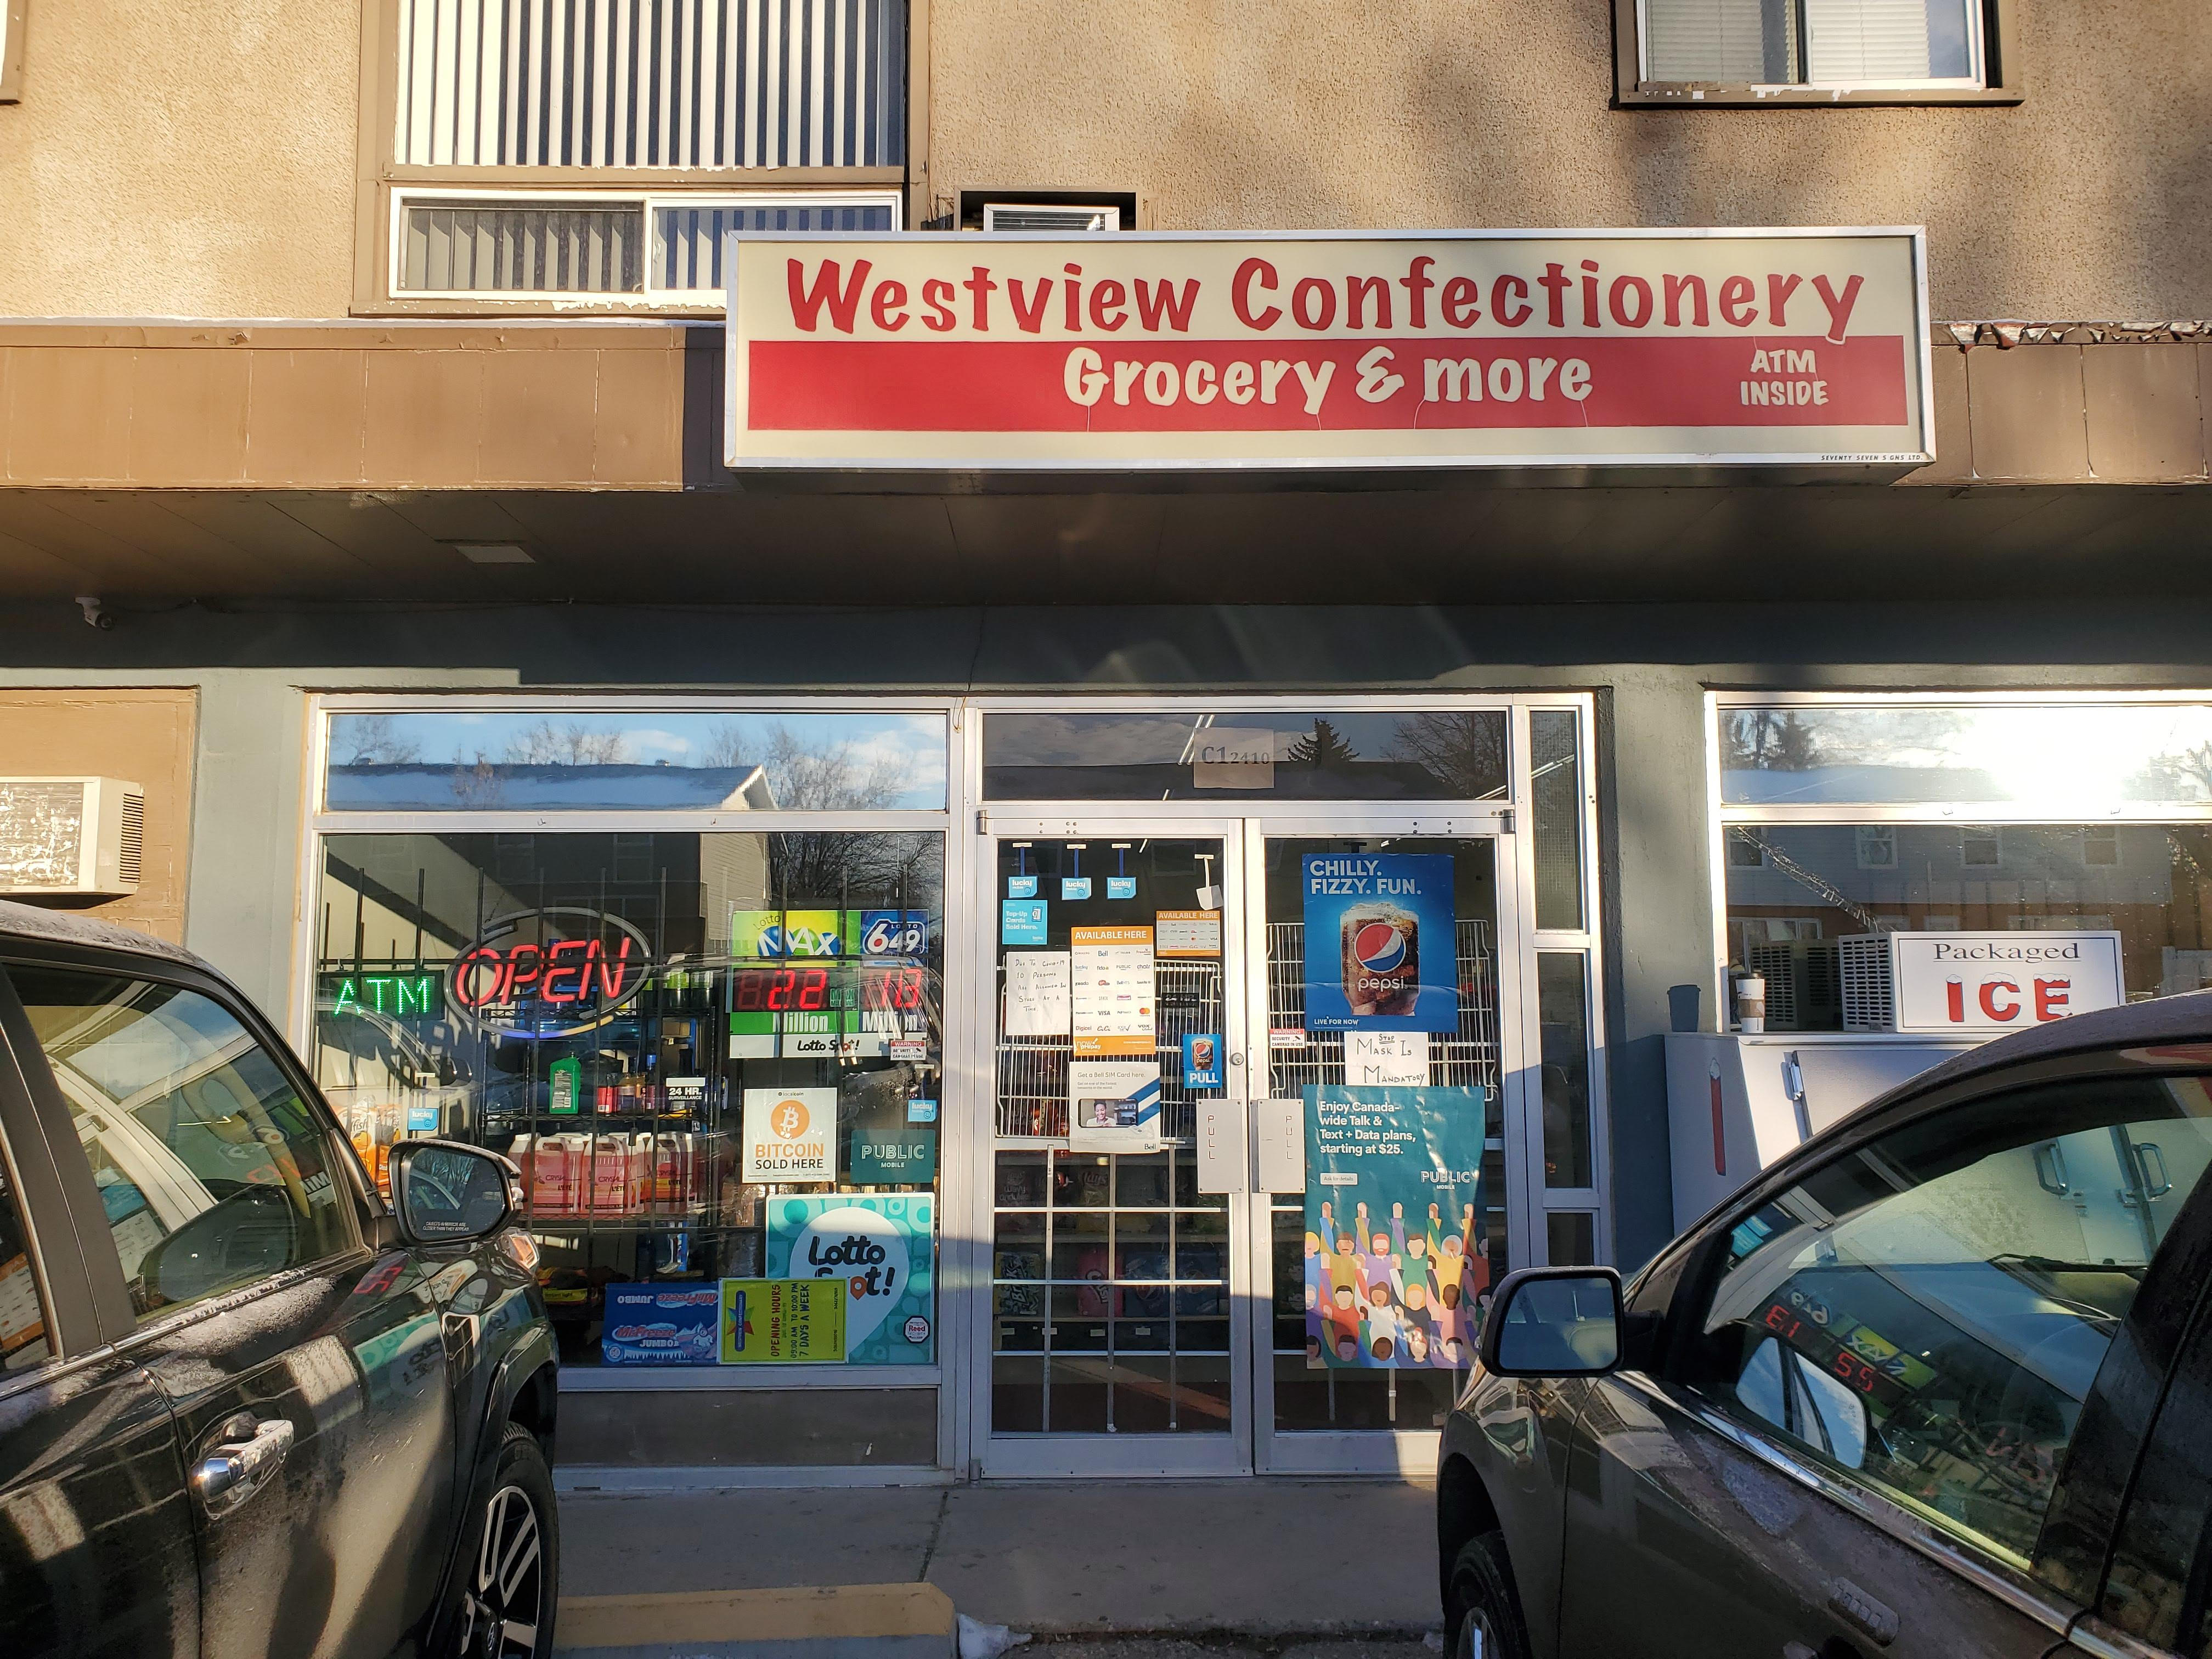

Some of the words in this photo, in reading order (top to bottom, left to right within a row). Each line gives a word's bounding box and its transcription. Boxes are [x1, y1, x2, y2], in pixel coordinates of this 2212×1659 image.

[787, 257, 1201, 334] Westview
[1231, 256, 1865, 344] Confectionery
[1750, 349, 1817, 374] ATM
[1063, 347, 1336, 415] Grocery
[1355, 346, 1405, 403] &
[1423, 357, 1593, 402] more
[1741, 381, 1830, 407] INSIDE
[1310, 860, 1382, 877] CHILLY.
[1311, 879, 1371, 894] FIZZY.
[1377, 879, 1421, 894] FUN.
[753, 913, 781, 930] Lotto
[867, 923, 921, 953] 649
[1124, 930, 1147, 939] HERE
[1933, 943, 2081, 964] Packaged
[456, 937, 631, 1007] OPEN
[1358, 975, 1404, 992] pepsi
[334, 978, 431, 1017] ATM
[1945, 972, 2073, 1023] ICE
[797, 1040, 826, 1051] Lotto
[1189, 1073, 1219, 1084] PULL
[1320, 1102, 1350, 1114] Enjoy
[1353, 1102, 1400, 1112] Canada-
[1320, 1116, 1347, 1126] wide
[1350, 1116, 1370, 1126] Talk
[1373, 1116, 1383, 1126] &
[1320, 1130, 1343, 1139] Text
[1355, 1130, 1380, 1140] Data
[1383, 1130, 1417, 1142] plans,
[755, 1143, 823, 1158] BITCOIN
[861, 1144, 925, 1159] PUBLIC
[1320, 1144, 1363, 1156] starting
[1365, 1145, 1376, 1154] at
[1379, 1144, 1403, 1154] $25.
[755, 1159, 788, 1170] SOLD
[792, 1159, 823, 1169] HERE
[1421, 1171, 1470, 1183] PUBLIC
[809, 1235, 885, 1266] Lotto
[792, 1283, 798, 1293] PM
[617, 1295, 654, 1304] JUMBO
[771, 1284, 781, 1313] HOURS
[800, 1284, 810, 1311] WEEK
[771, 1317, 780, 1356] OPENING
[791, 1327, 798, 1336] AM
[799, 1325, 809, 1347] DAYS
